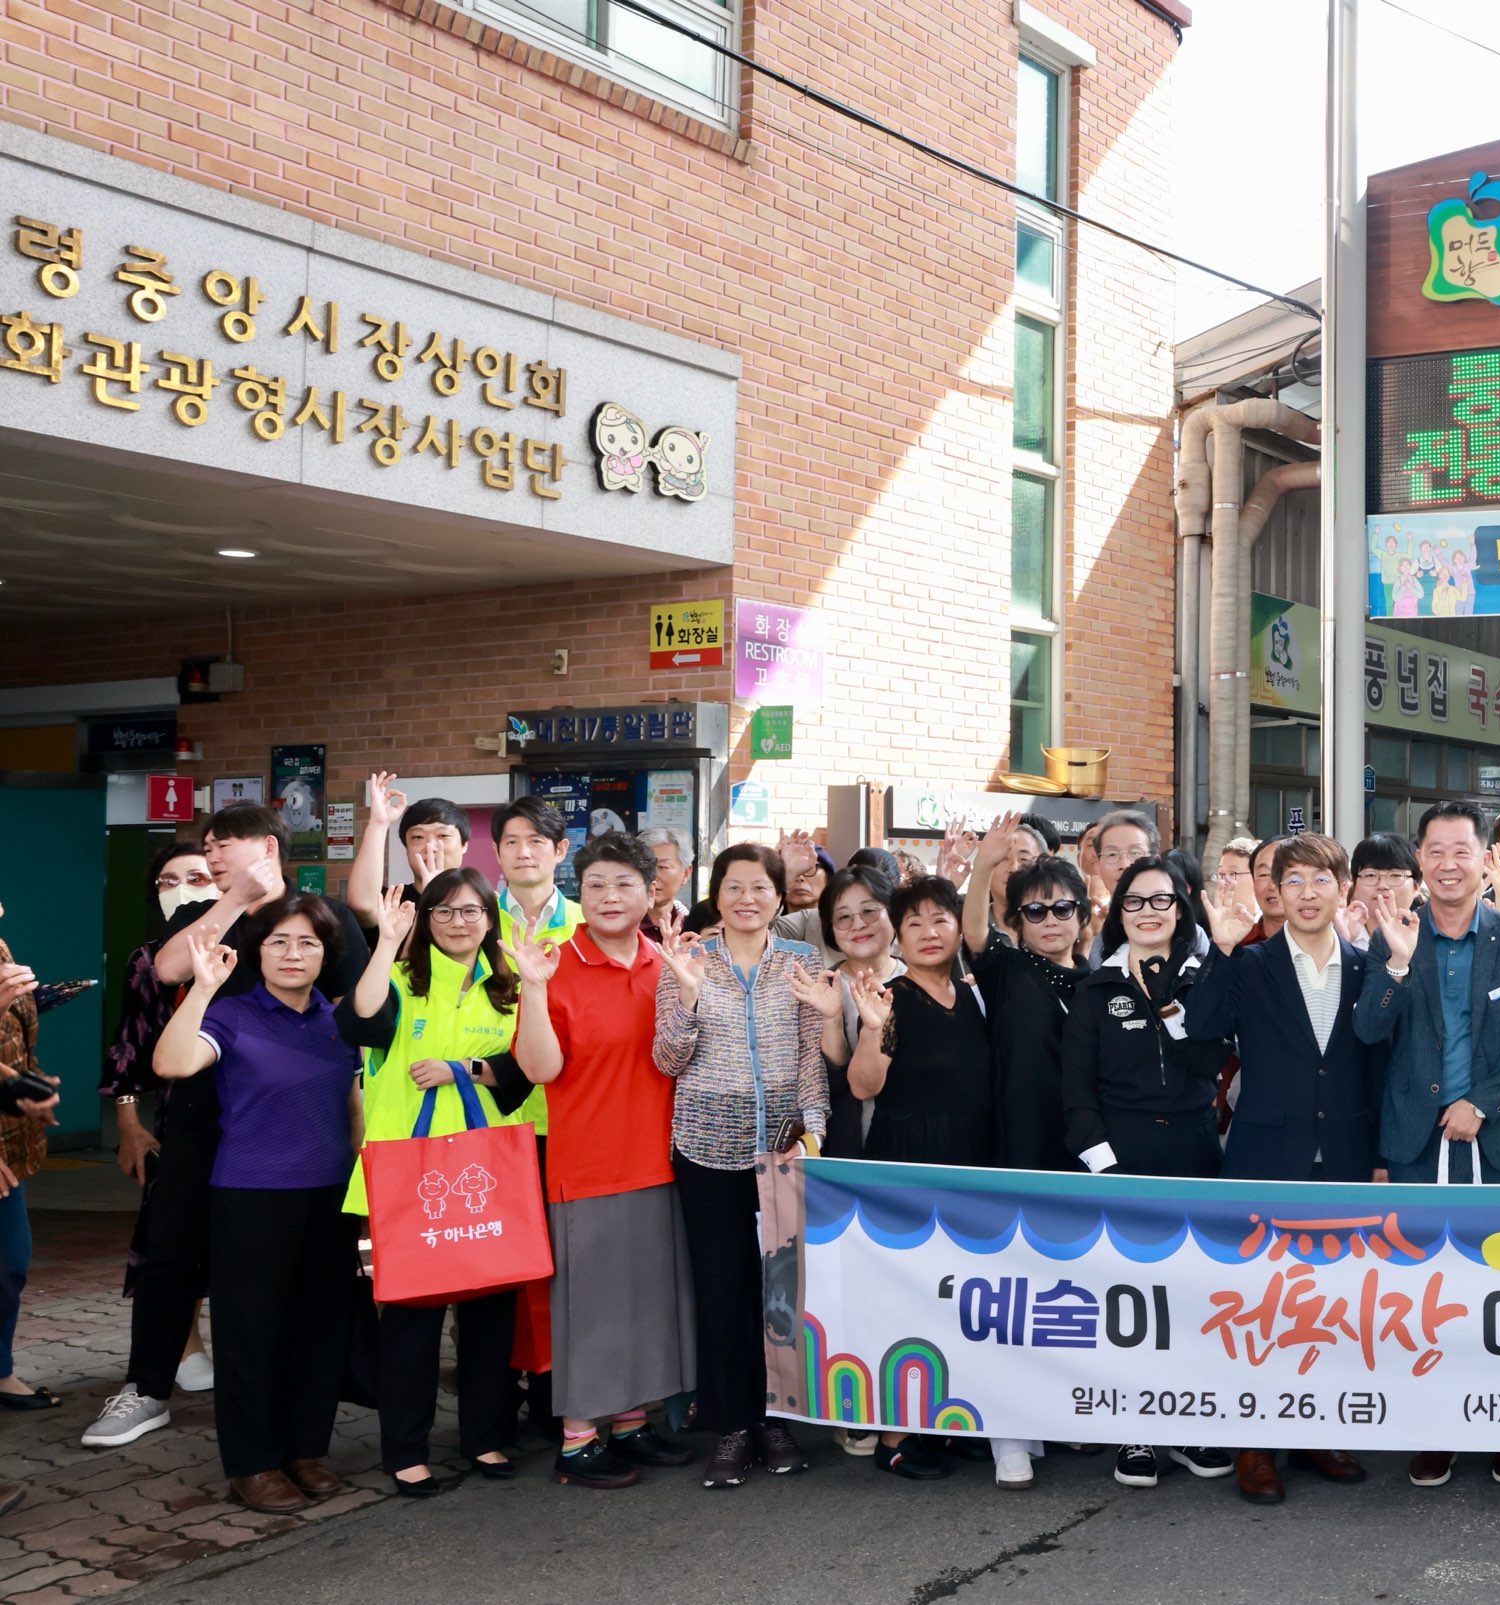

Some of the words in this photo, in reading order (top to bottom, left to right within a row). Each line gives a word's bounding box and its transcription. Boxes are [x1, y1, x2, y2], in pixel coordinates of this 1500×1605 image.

[677, 626, 718, 645] 화장실
[745, 641, 818, 668] RESTROOM
[1362, 636, 1449, 722] 풍년집
[775, 743, 791, 752] AED
[444, 1220, 503, 1243] 하나은행
[1200, 1263, 1469, 1377] 전통시장
[1071, 1386, 1127, 1416] 일시:
[1138, 1390, 1227, 1419] 2025.
[1238, 1392, 1267, 1420] 9.
[1277, 1392, 1326, 1421] 26.
[1337, 1391, 1388, 1425] (금)
